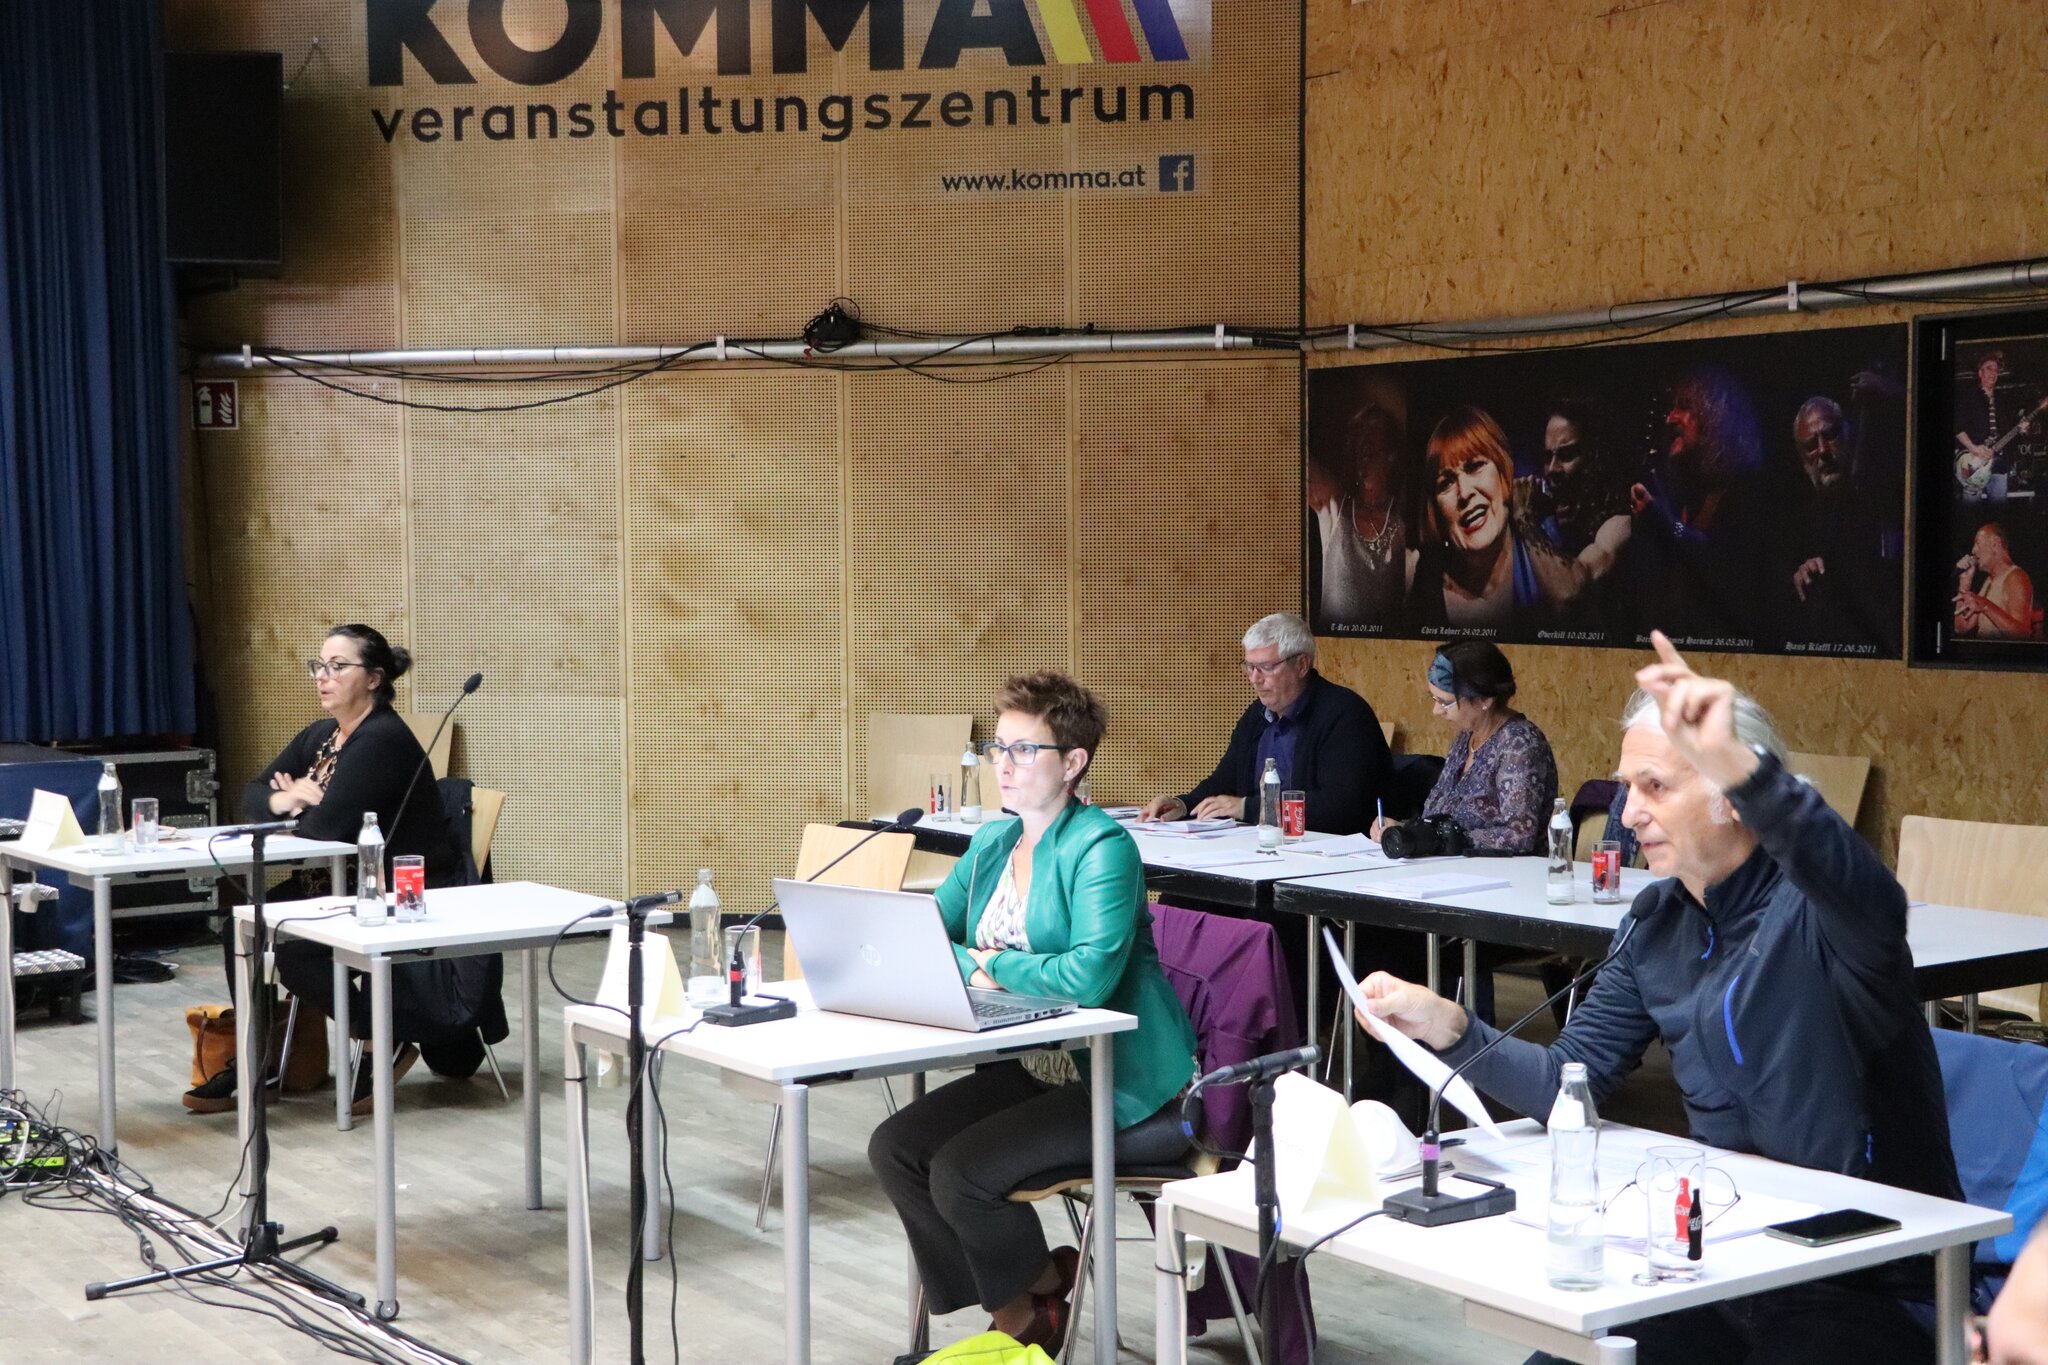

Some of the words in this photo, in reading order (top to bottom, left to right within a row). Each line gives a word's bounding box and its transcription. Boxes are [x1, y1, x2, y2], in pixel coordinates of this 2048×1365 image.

[366, 0, 1047, 87] KOMMA
[371, 76, 1195, 143] veranstaltungszentrum
[941, 164, 1146, 192] www.komma.at
